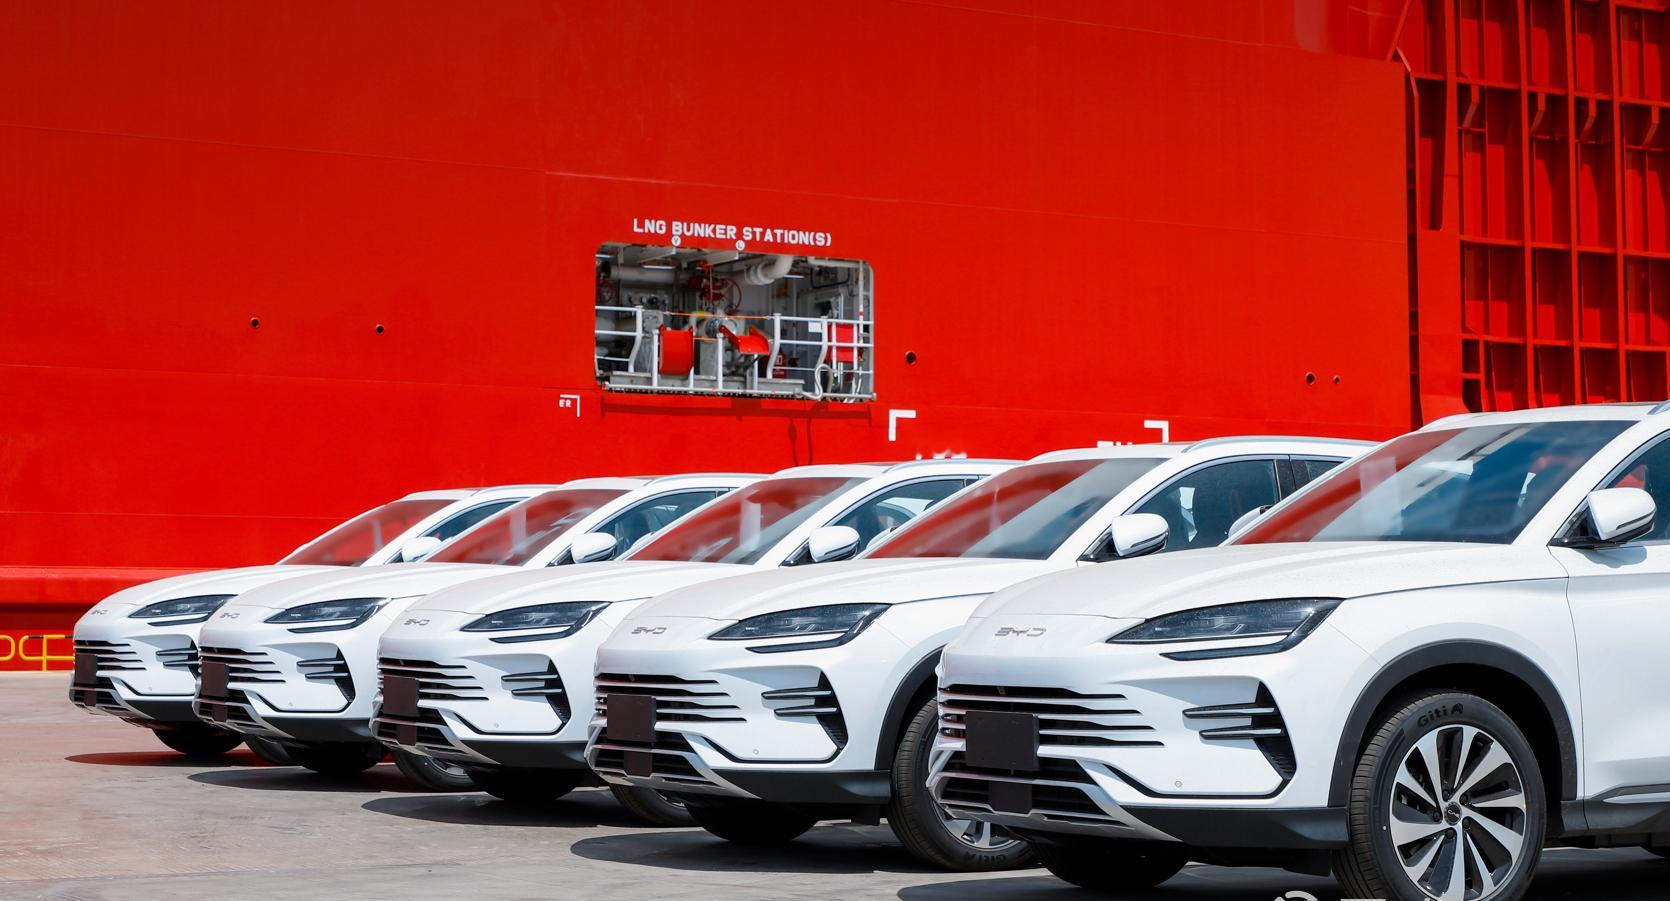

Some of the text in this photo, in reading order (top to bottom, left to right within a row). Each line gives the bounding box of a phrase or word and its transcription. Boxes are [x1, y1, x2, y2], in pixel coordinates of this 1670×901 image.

[633, 218, 832, 246] LNG BUNKER STATION(S)
[631, 626, 667, 635] BYD
[994, 627, 1047, 637] BYD
